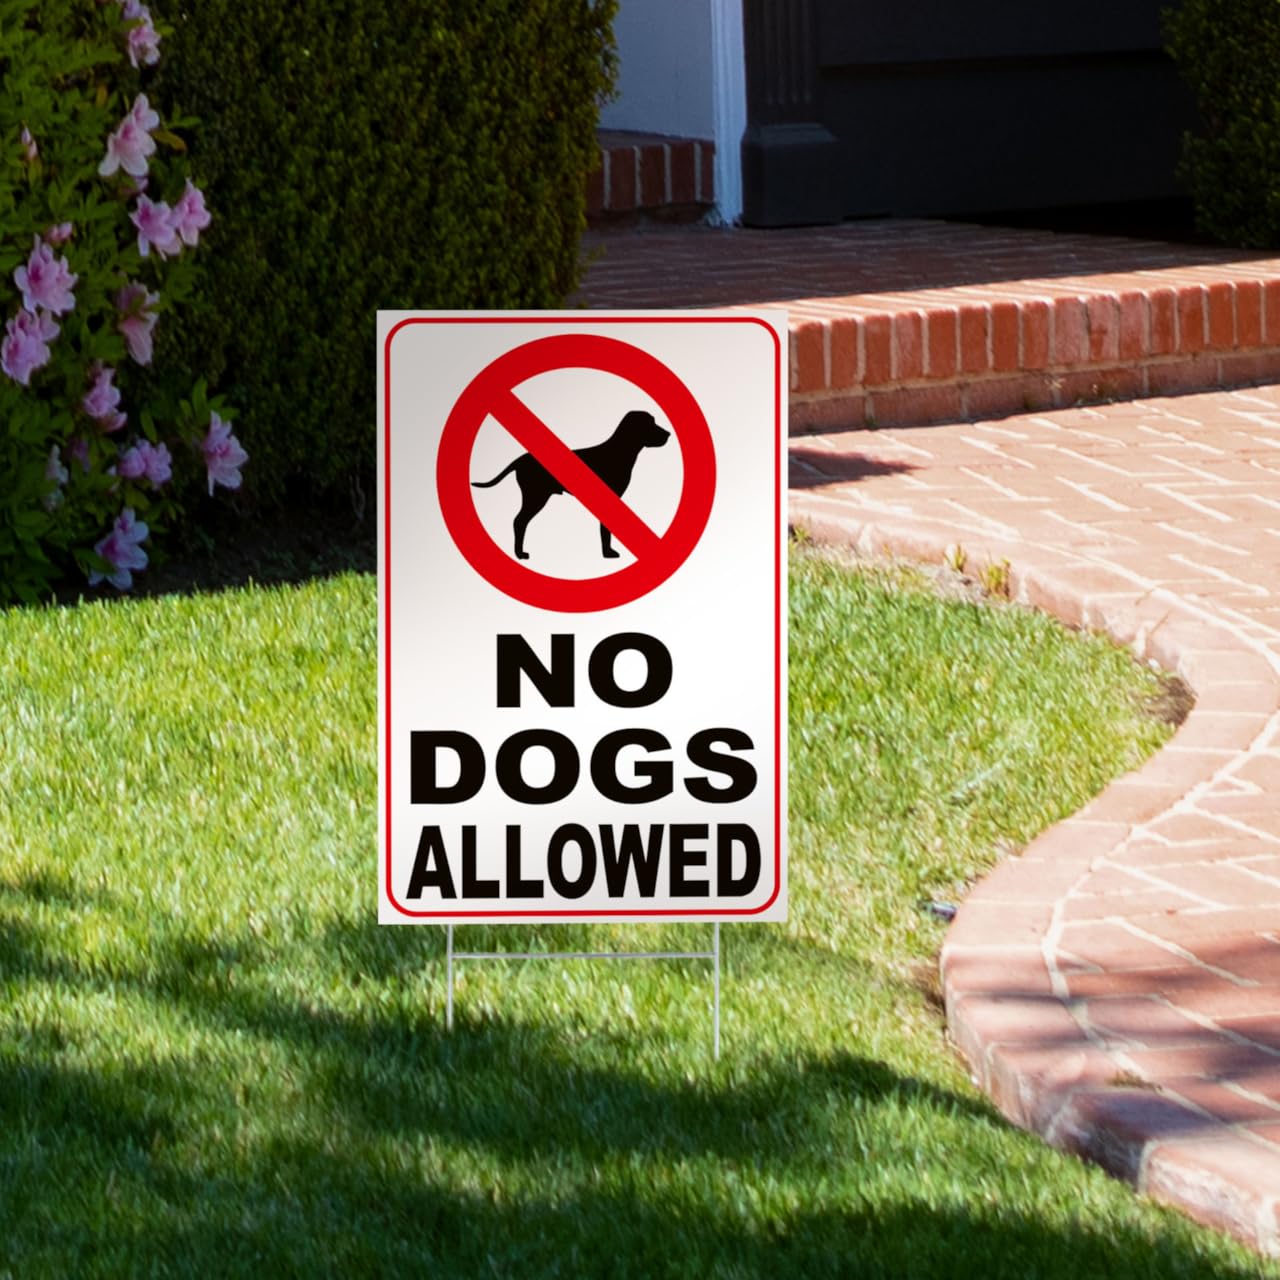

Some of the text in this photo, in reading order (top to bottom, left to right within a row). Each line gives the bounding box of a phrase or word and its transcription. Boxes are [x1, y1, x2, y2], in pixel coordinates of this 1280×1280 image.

[496, 632, 673, 709] NO
[410, 727, 758, 805] DOGS
[405, 823, 762, 900] ALLOWED
